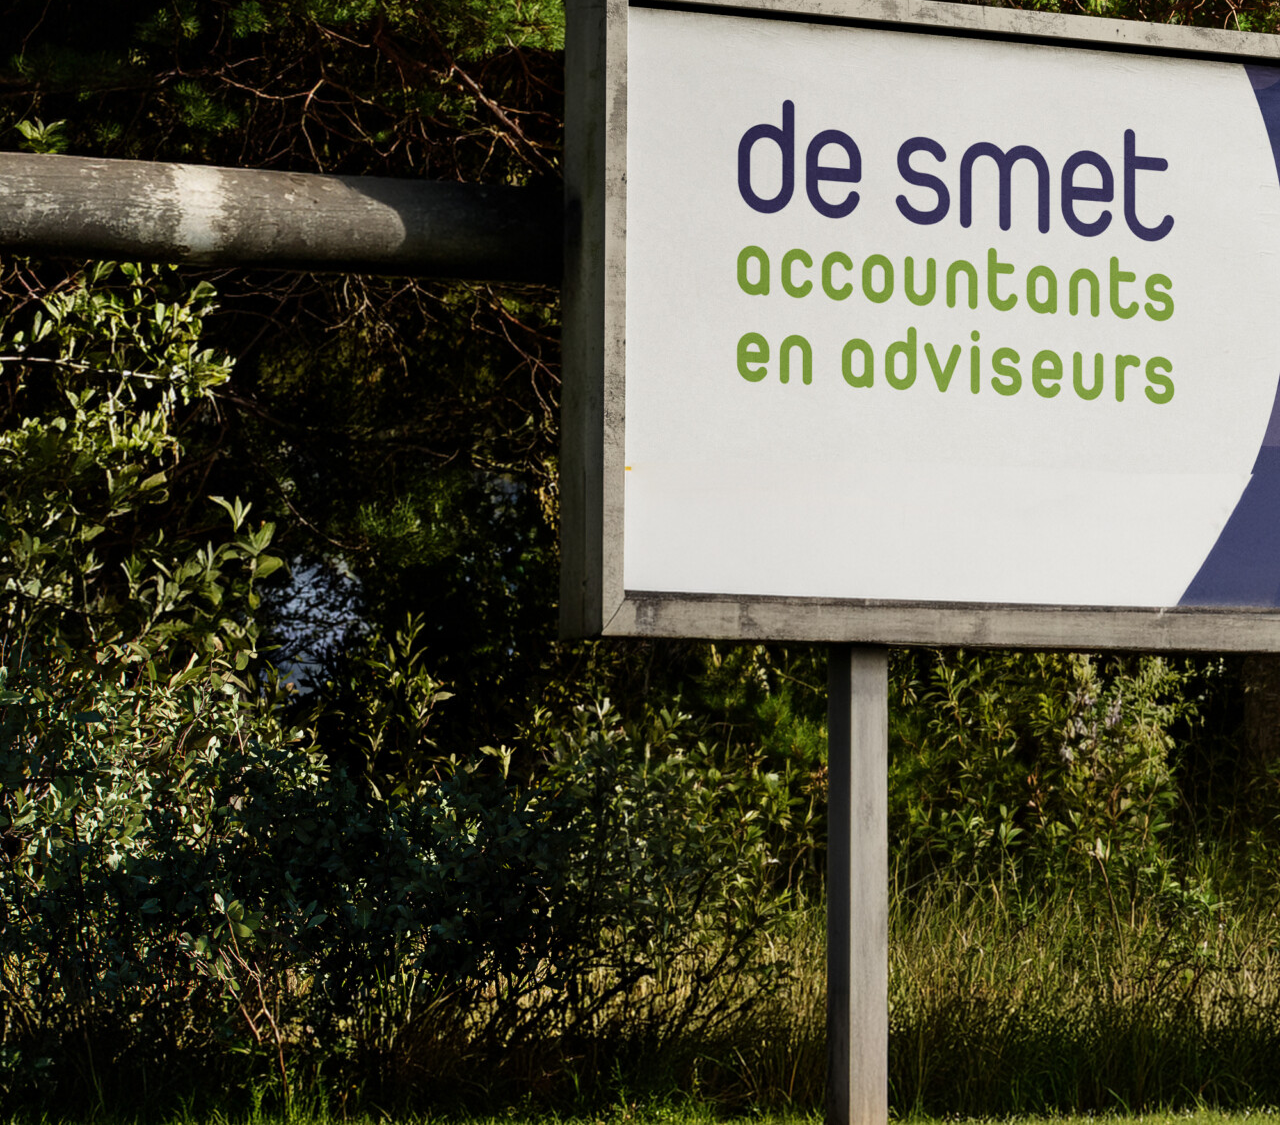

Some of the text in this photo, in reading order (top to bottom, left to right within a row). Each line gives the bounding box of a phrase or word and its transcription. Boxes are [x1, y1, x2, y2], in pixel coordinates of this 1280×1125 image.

[738, 100, 1174, 241] de smet
[737, 246, 1174, 321] accountants
[737, 327, 1174, 404] en adviseurs
